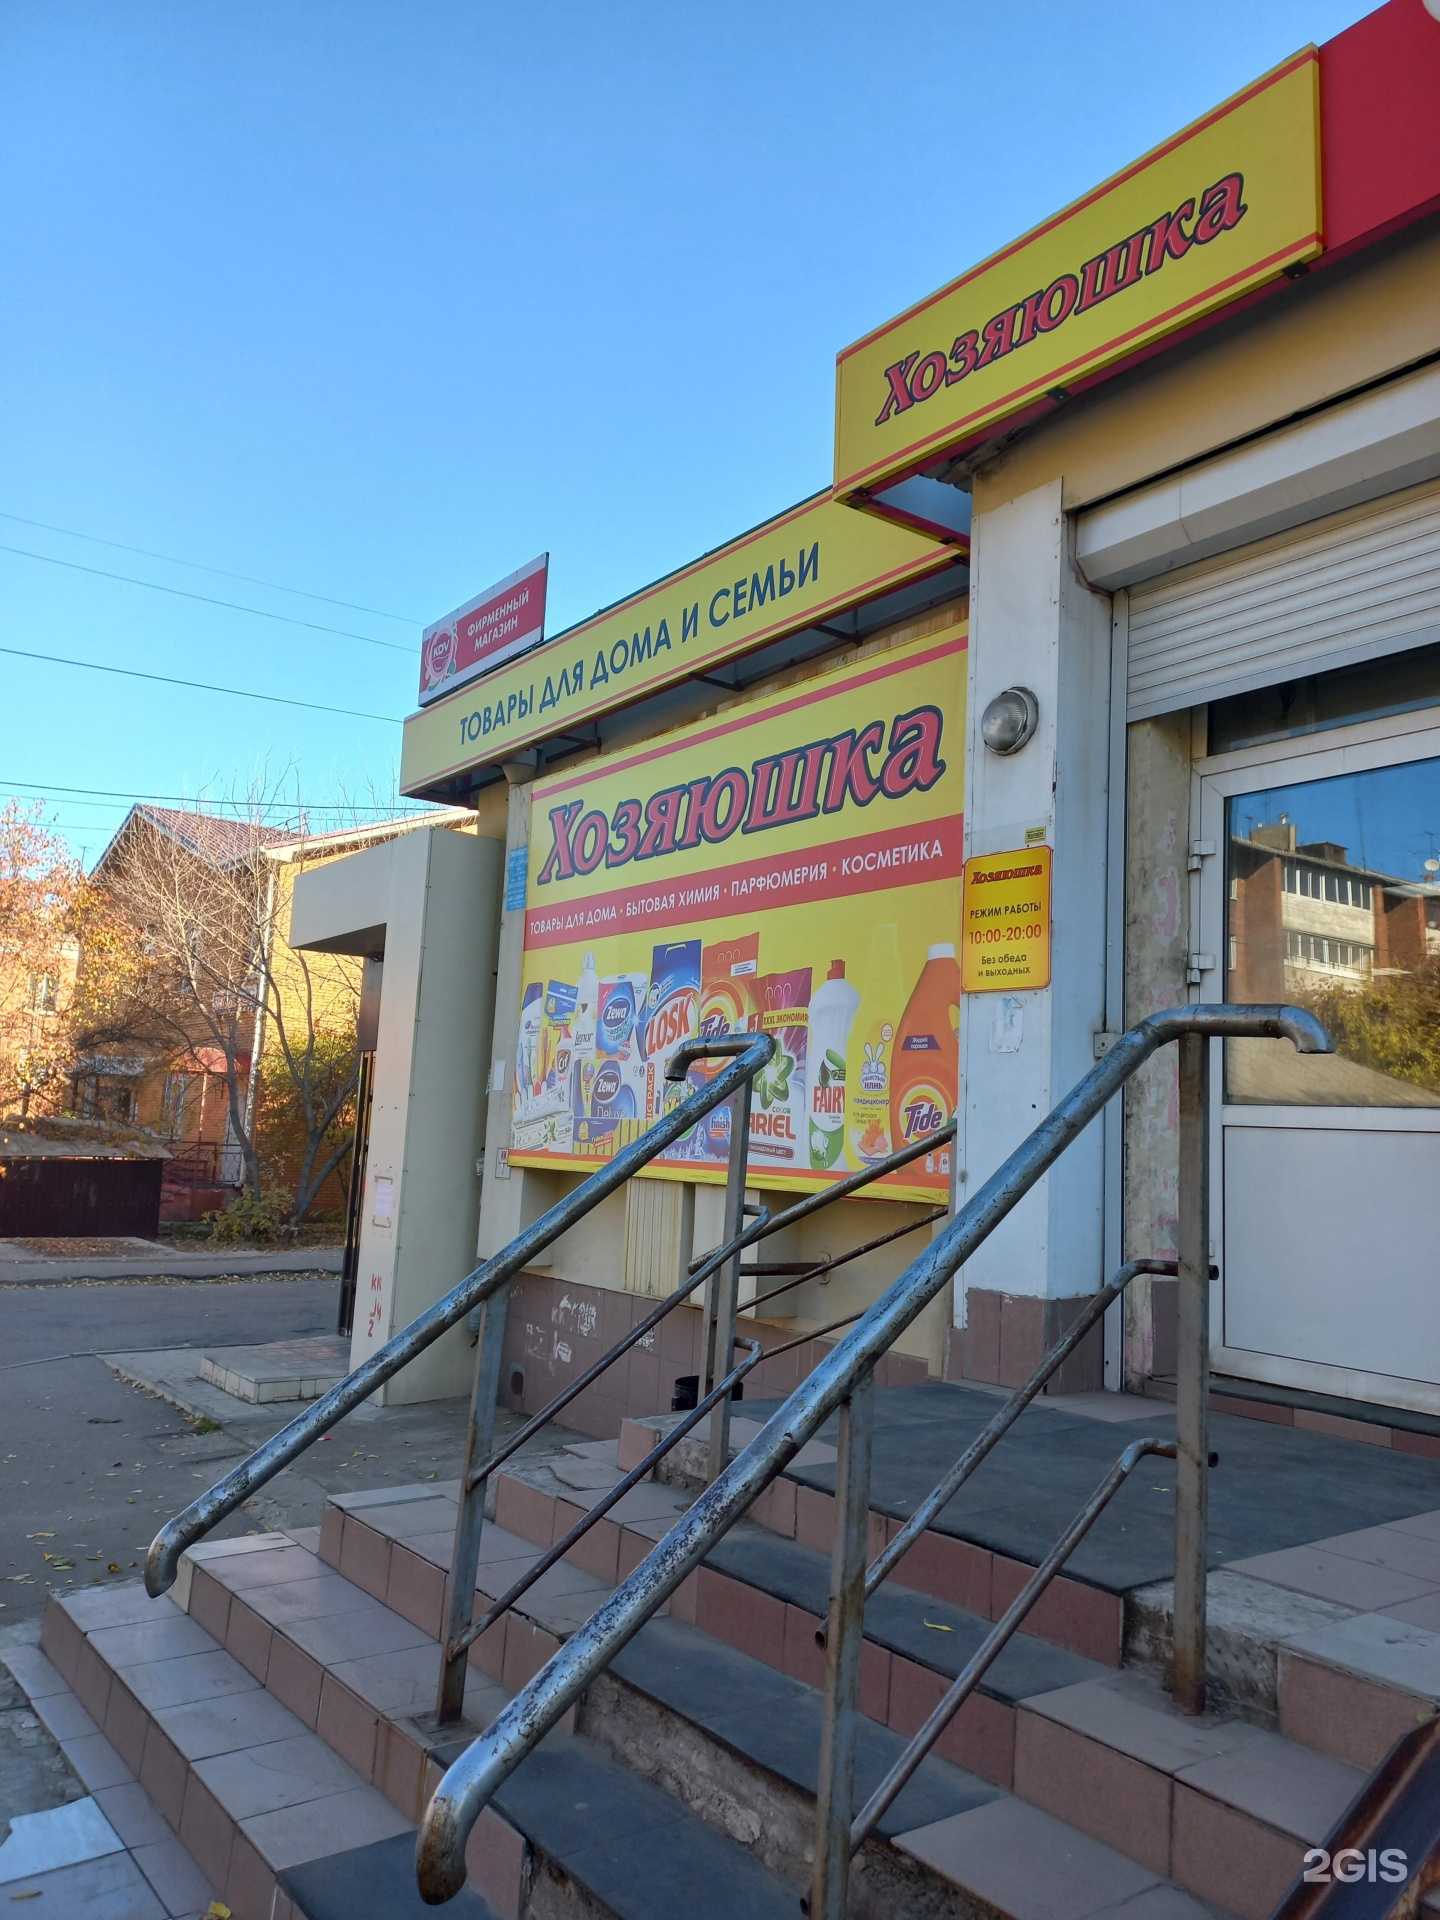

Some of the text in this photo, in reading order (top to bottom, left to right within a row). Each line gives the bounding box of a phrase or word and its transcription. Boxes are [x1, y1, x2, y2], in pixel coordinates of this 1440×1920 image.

[874, 172, 1249, 427] Хозяюшка
[467, 587, 529, 637] ФИРМЕННЫЙ
[433, 639, 450, 657] KDV
[460, 541, 819, 745] ТОВАРЫ ДЛЯ ДОМА И СЕМЬИ
[474, 616, 518, 652] МАГАЗИН
[537, 704, 947, 885] Хозяюшка
[530, 839, 943, 935] ТОВАРЫ ДЛЯ ДОМА БЫТОВАЯ ХИМИЯ ПАРФЮМЕРИЯ КОСМЕТИКА
[970, 902, 1042, 919] РЕЖИМ РАБОТЫ
[969, 924, 1042, 944] 10:00-20:00
[981, 954, 1027, 965] Без обеда
[985, 967, 1031, 977] выходных
[606, 1006, 626, 1020] Zewa
[646, 996, 691, 1056] LOSK
[597, 1079, 617, 1093] Zewa
[904, 1103, 943, 1138] Tide
